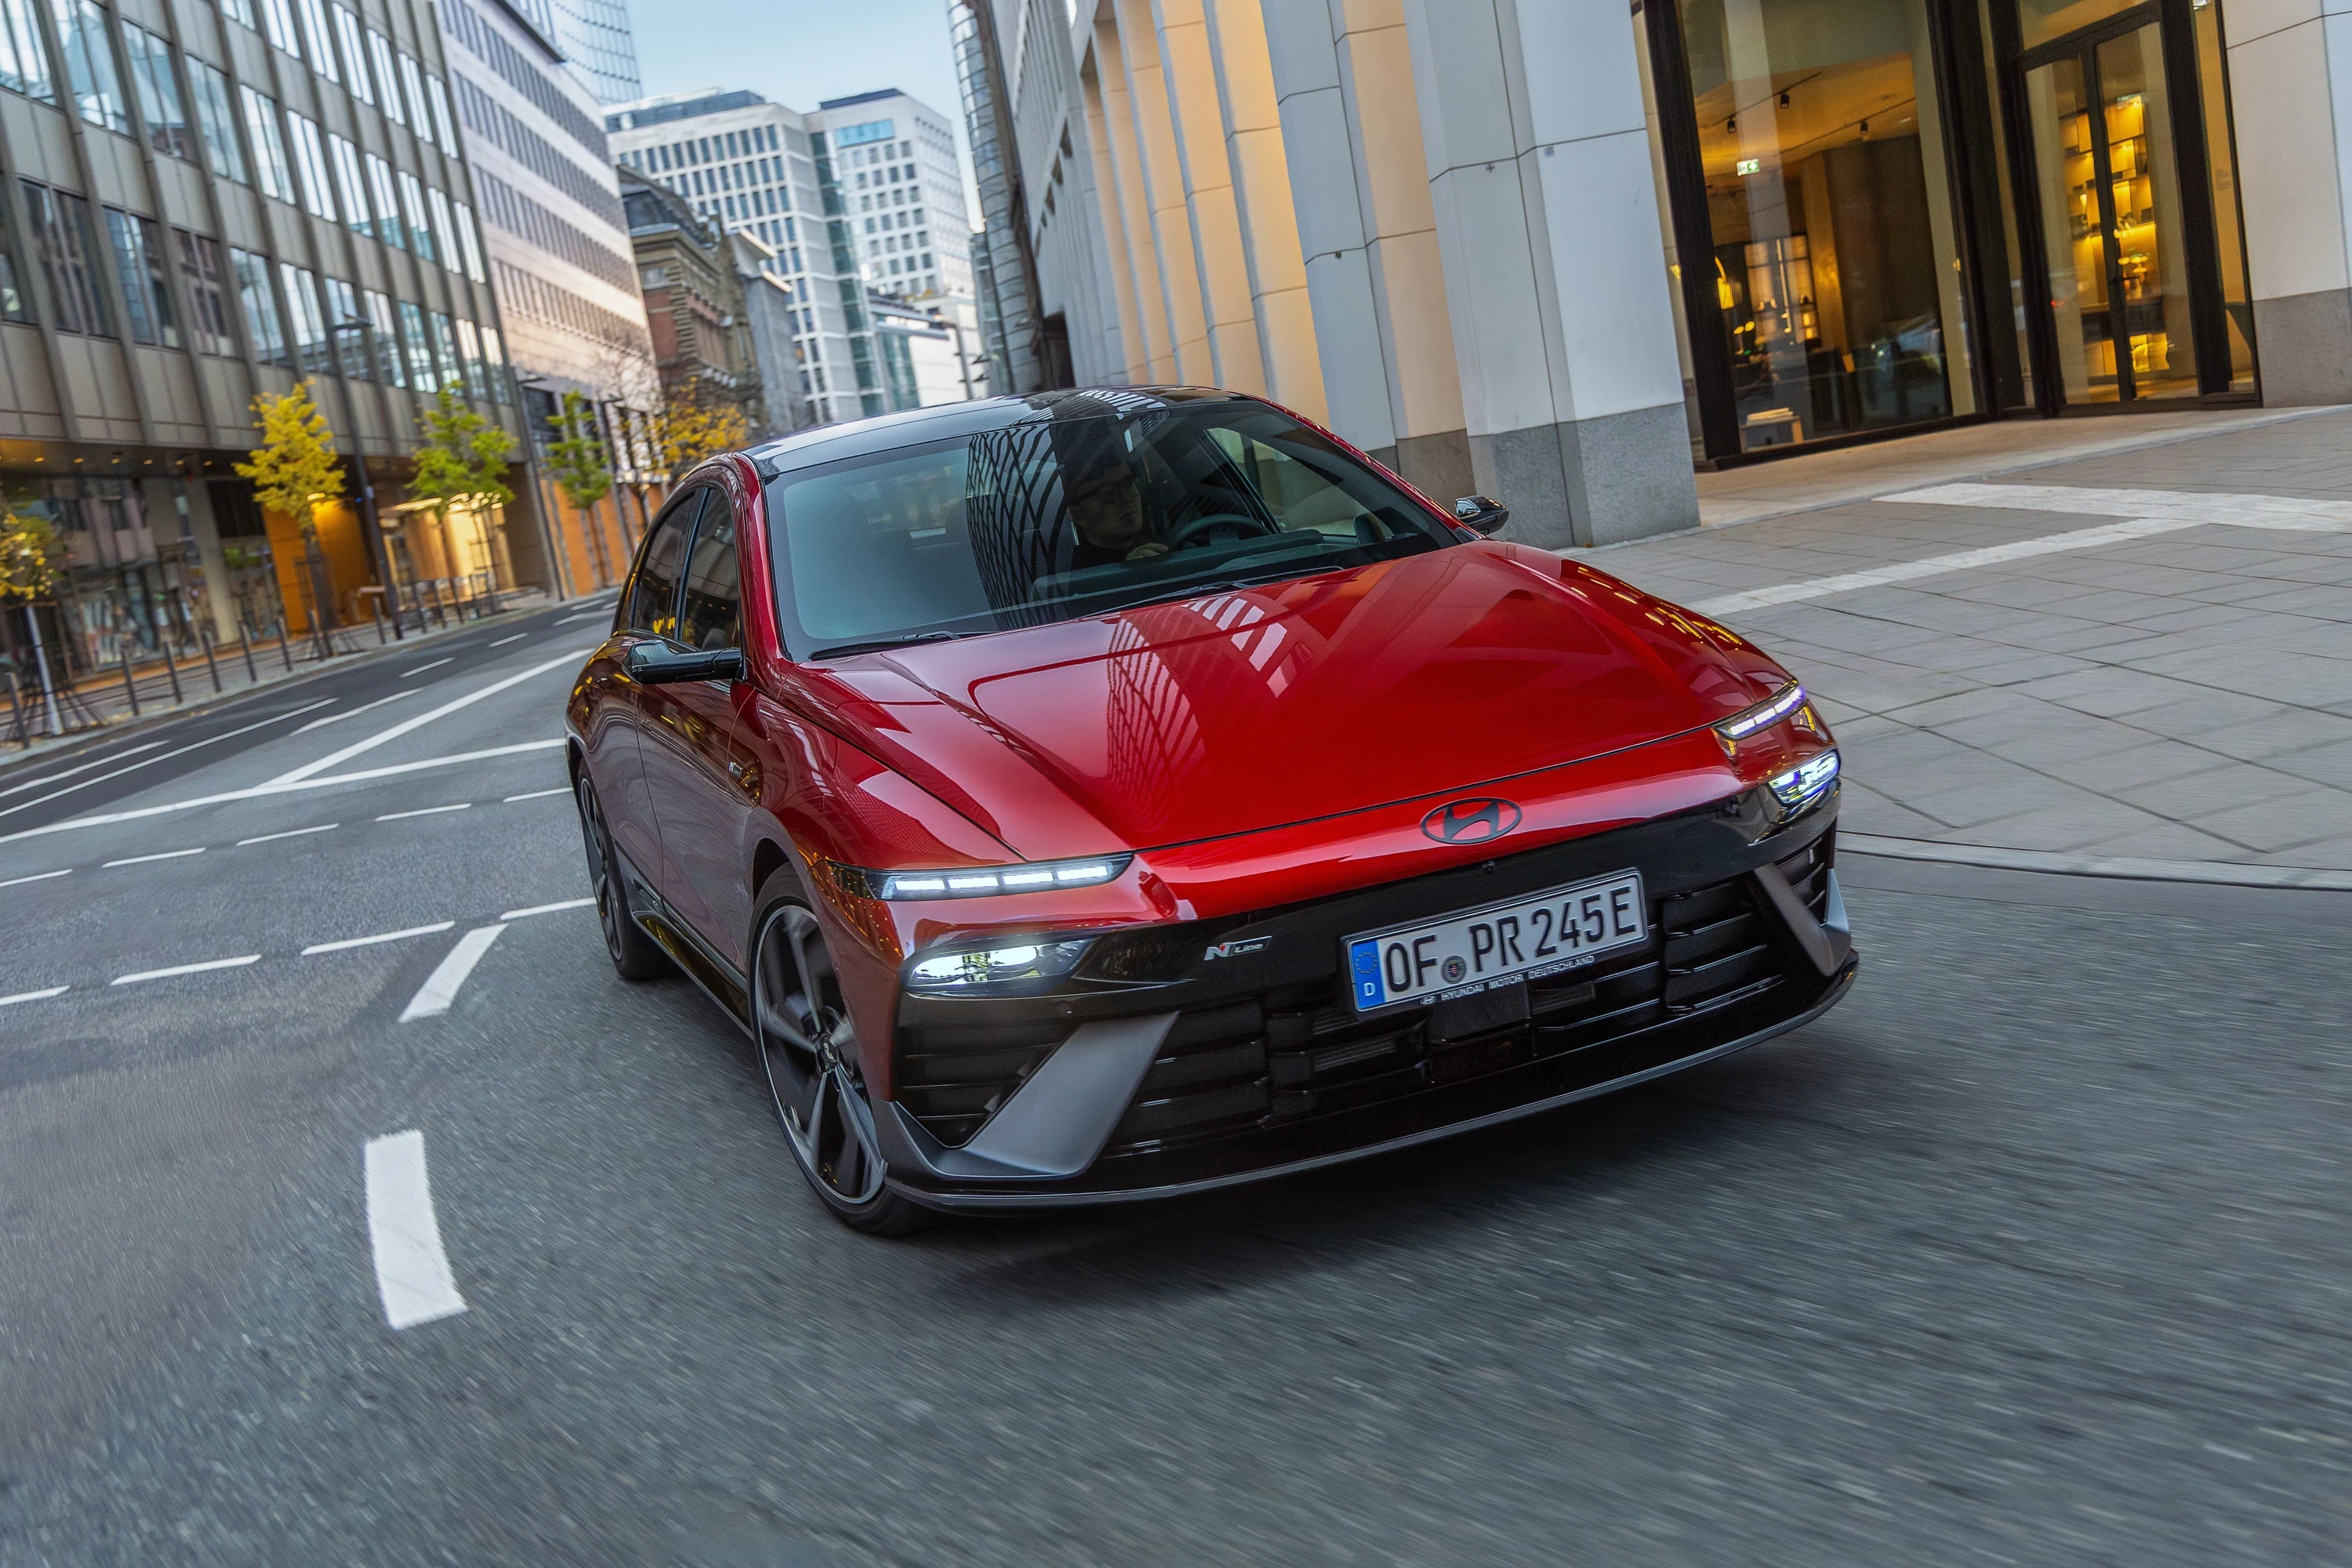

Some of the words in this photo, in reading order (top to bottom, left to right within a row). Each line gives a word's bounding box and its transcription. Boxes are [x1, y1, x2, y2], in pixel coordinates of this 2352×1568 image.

[1385, 934, 1439, 993] OF
[1467, 914, 1525, 972] PR
[1530, 885, 1637, 957] 245E
[1363, 982, 1376, 996] D
[1441, 984, 1484, 1000] HYUNDAI
[1489, 974, 1523, 989] MOTOR
[1528, 956, 1595, 979] DEUTSCHLAND
